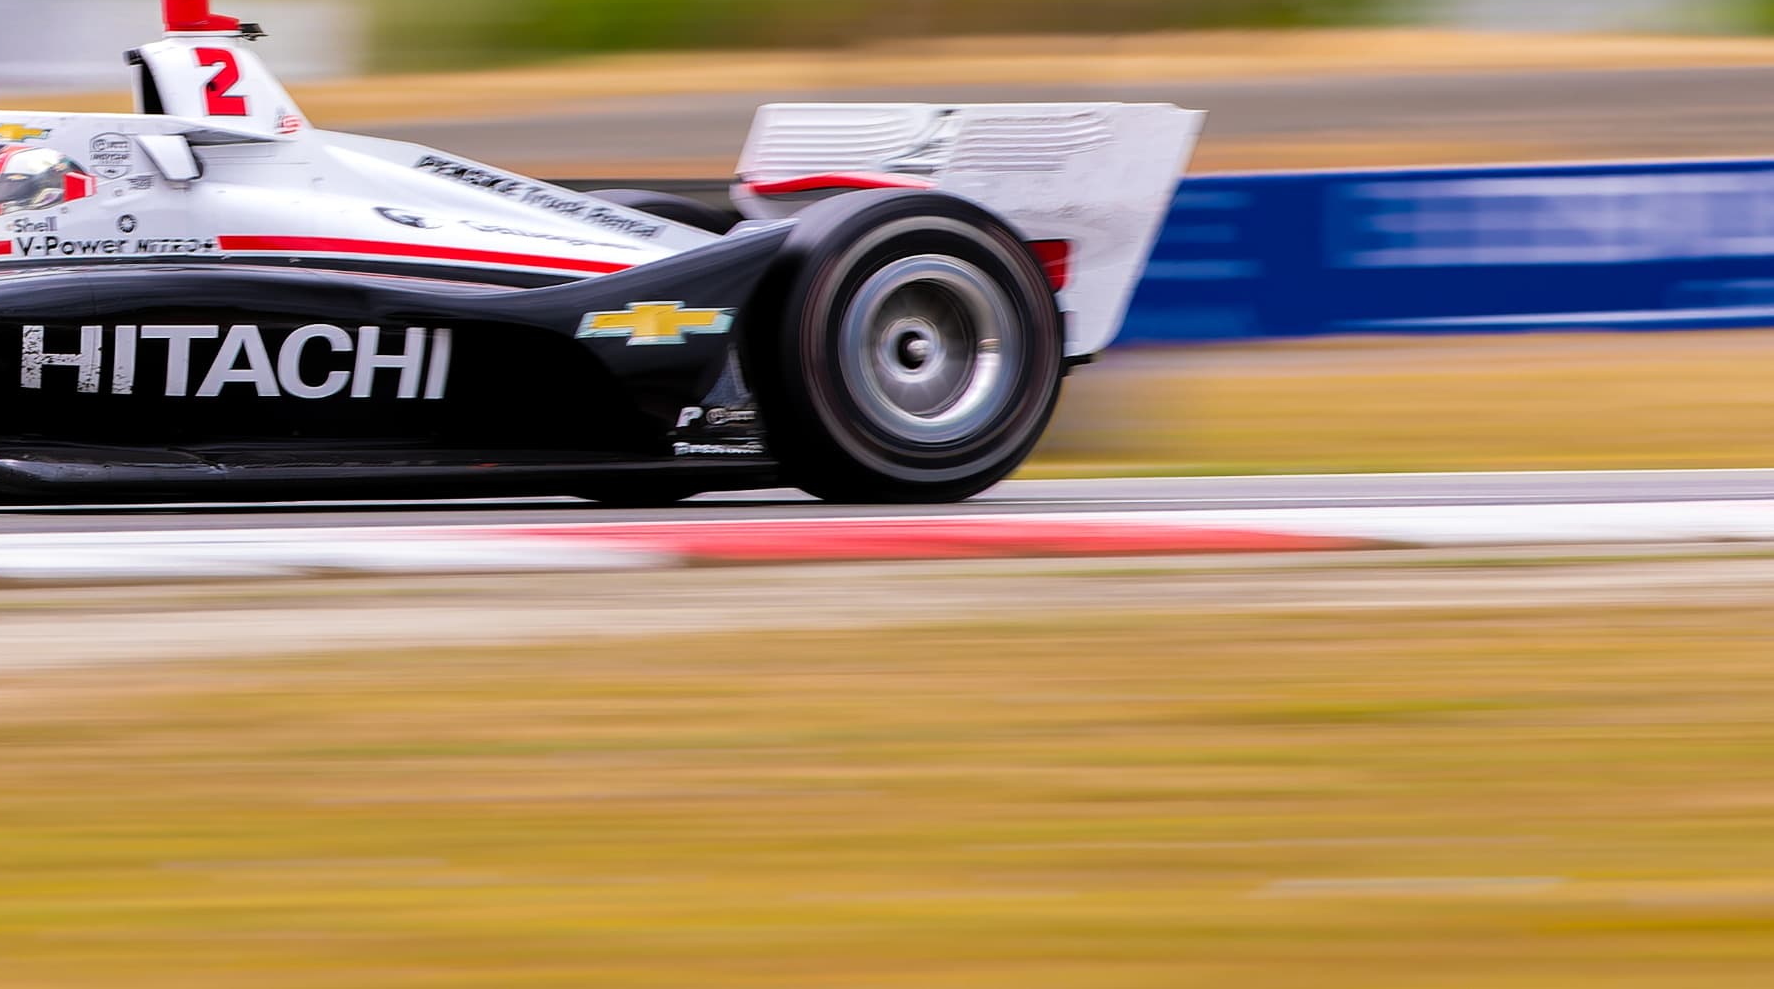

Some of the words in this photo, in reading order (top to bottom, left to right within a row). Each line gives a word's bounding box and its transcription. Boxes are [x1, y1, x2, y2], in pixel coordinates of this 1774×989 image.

[191, 47, 249, 116] 2
[520, 185, 589, 217] Truck
[12, 216, 58, 233] Shell
[16, 235, 130, 257] V-Power
[20, 324, 453, 399] HITACHI
